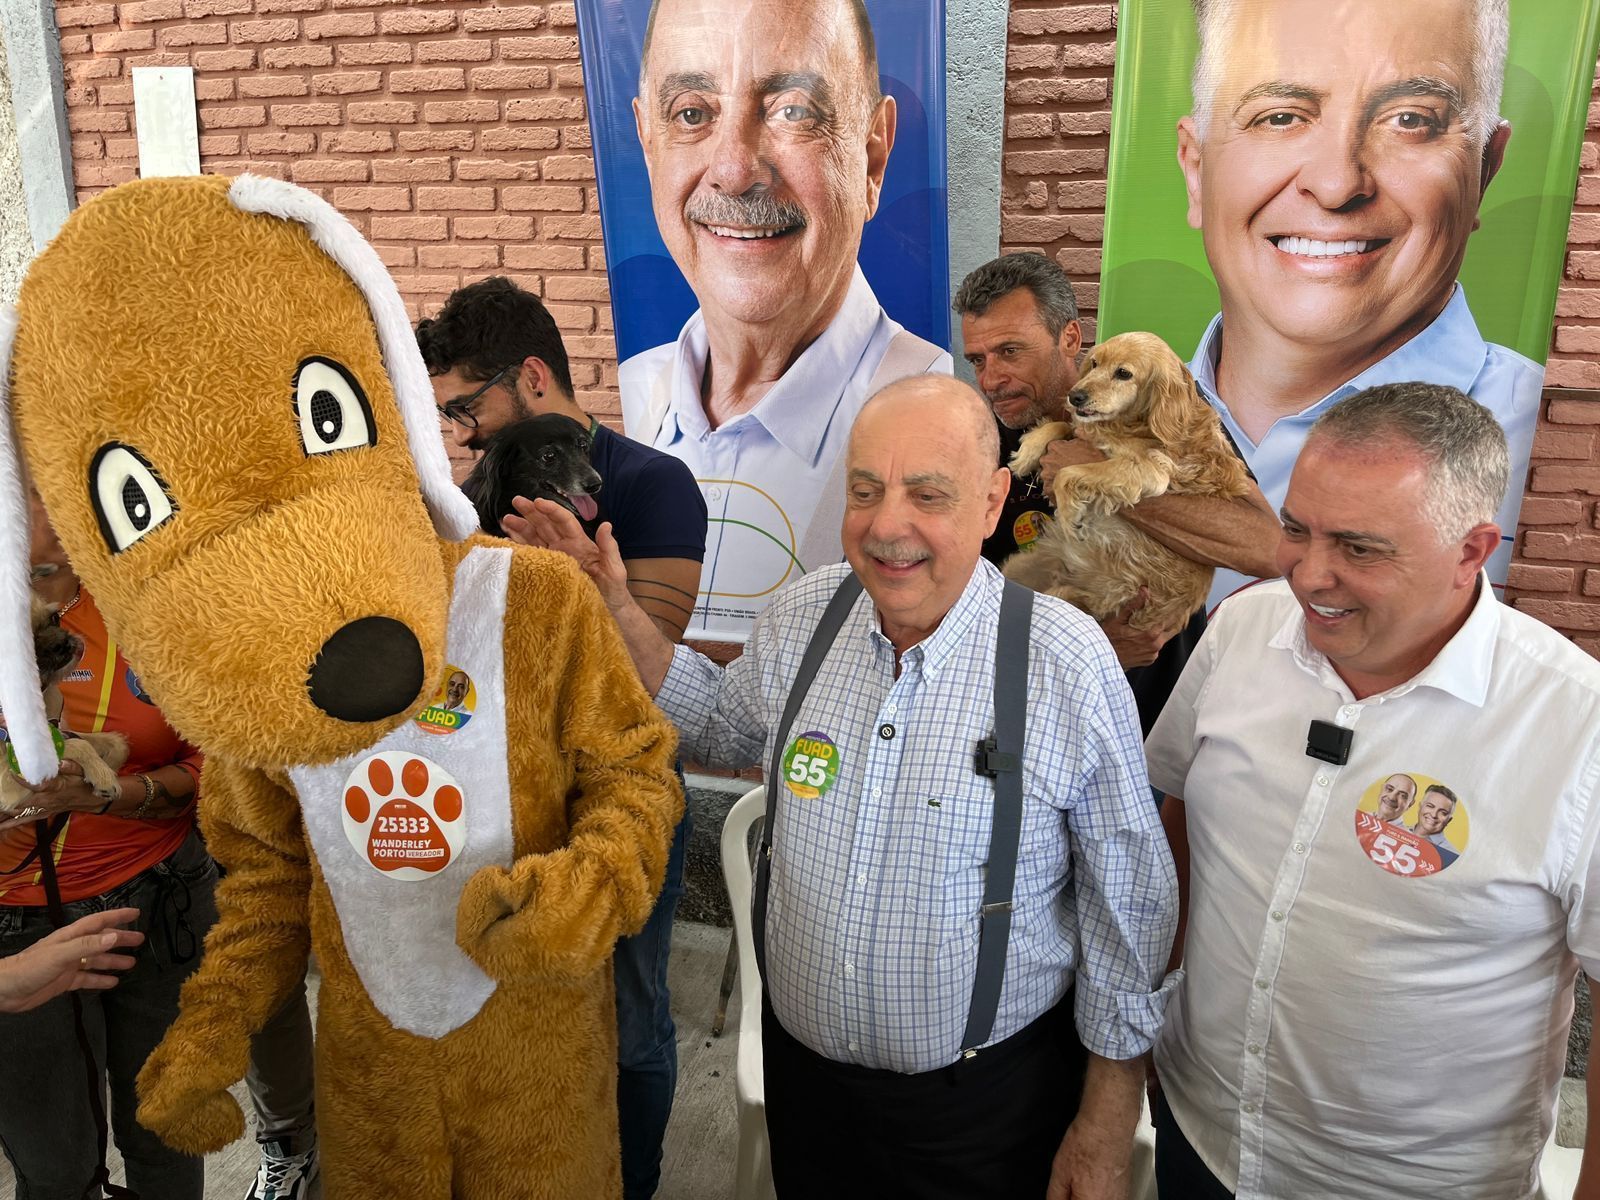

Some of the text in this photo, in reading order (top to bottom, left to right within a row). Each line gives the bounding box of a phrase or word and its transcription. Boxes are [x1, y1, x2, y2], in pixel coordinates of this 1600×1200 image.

[1015, 523, 1032, 538] 55
[419, 708, 456, 726] FUAD
[796, 738, 833, 760] FUAD
[789, 753, 829, 787] 55
[378, 816, 430, 834] 25333
[372, 838, 432, 849] WANDERLEY
[373, 848, 442, 858] PORTO VEREADOR
[1369, 833, 1421, 875] 55
